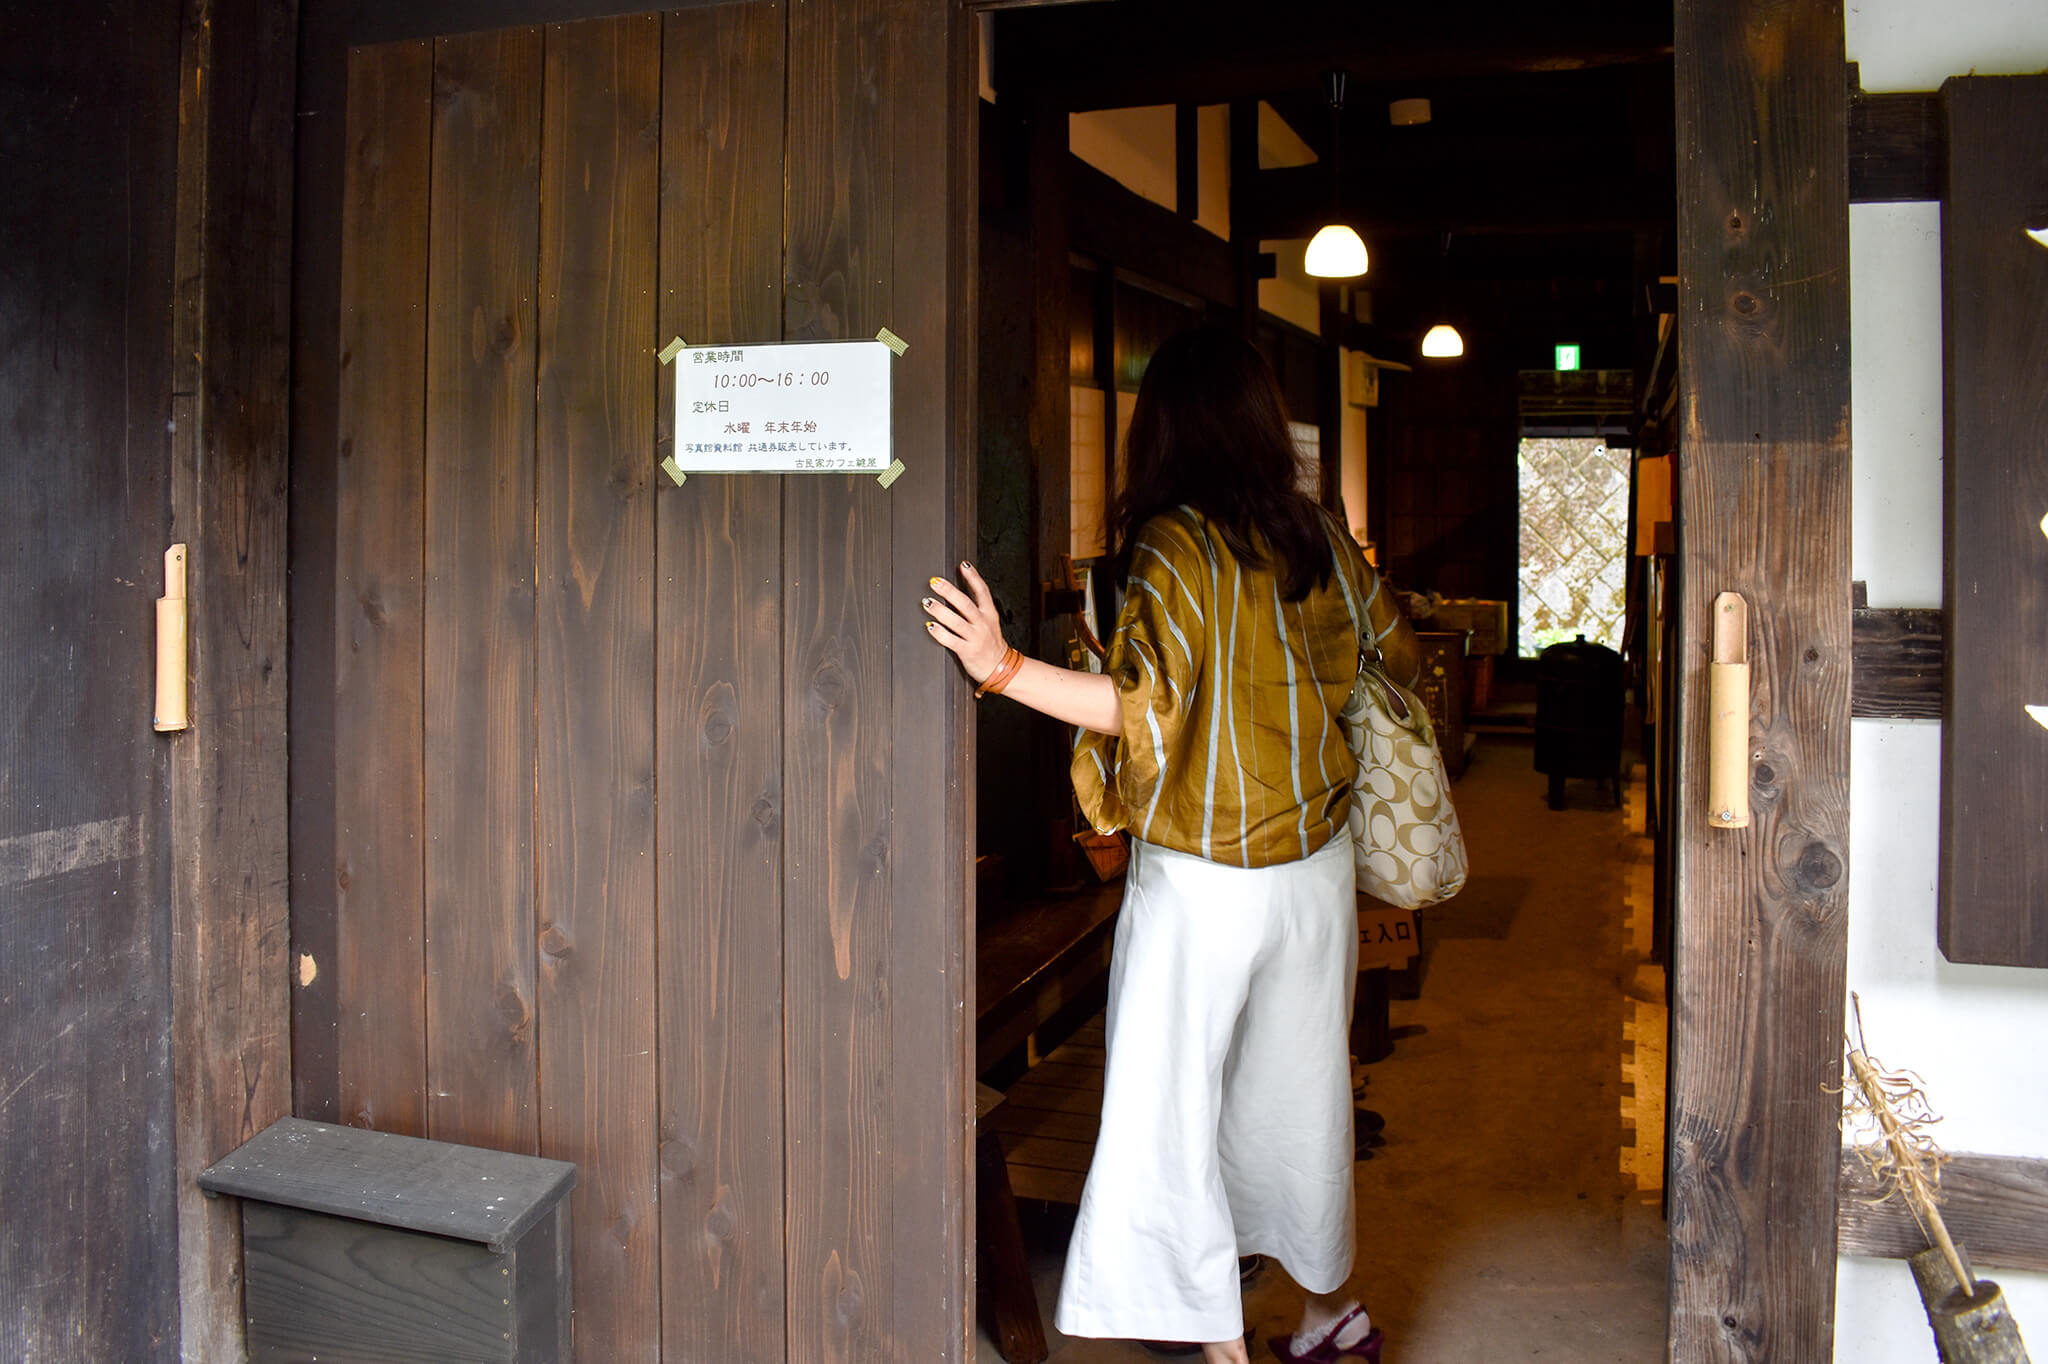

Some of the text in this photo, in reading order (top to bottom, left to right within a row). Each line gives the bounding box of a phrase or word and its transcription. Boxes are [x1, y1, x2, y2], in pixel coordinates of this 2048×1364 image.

[693, 350, 743, 364] 営業時間
[692, 400, 729, 413] 定休日
[724, 421, 817, 433] 水曜 年末年始
